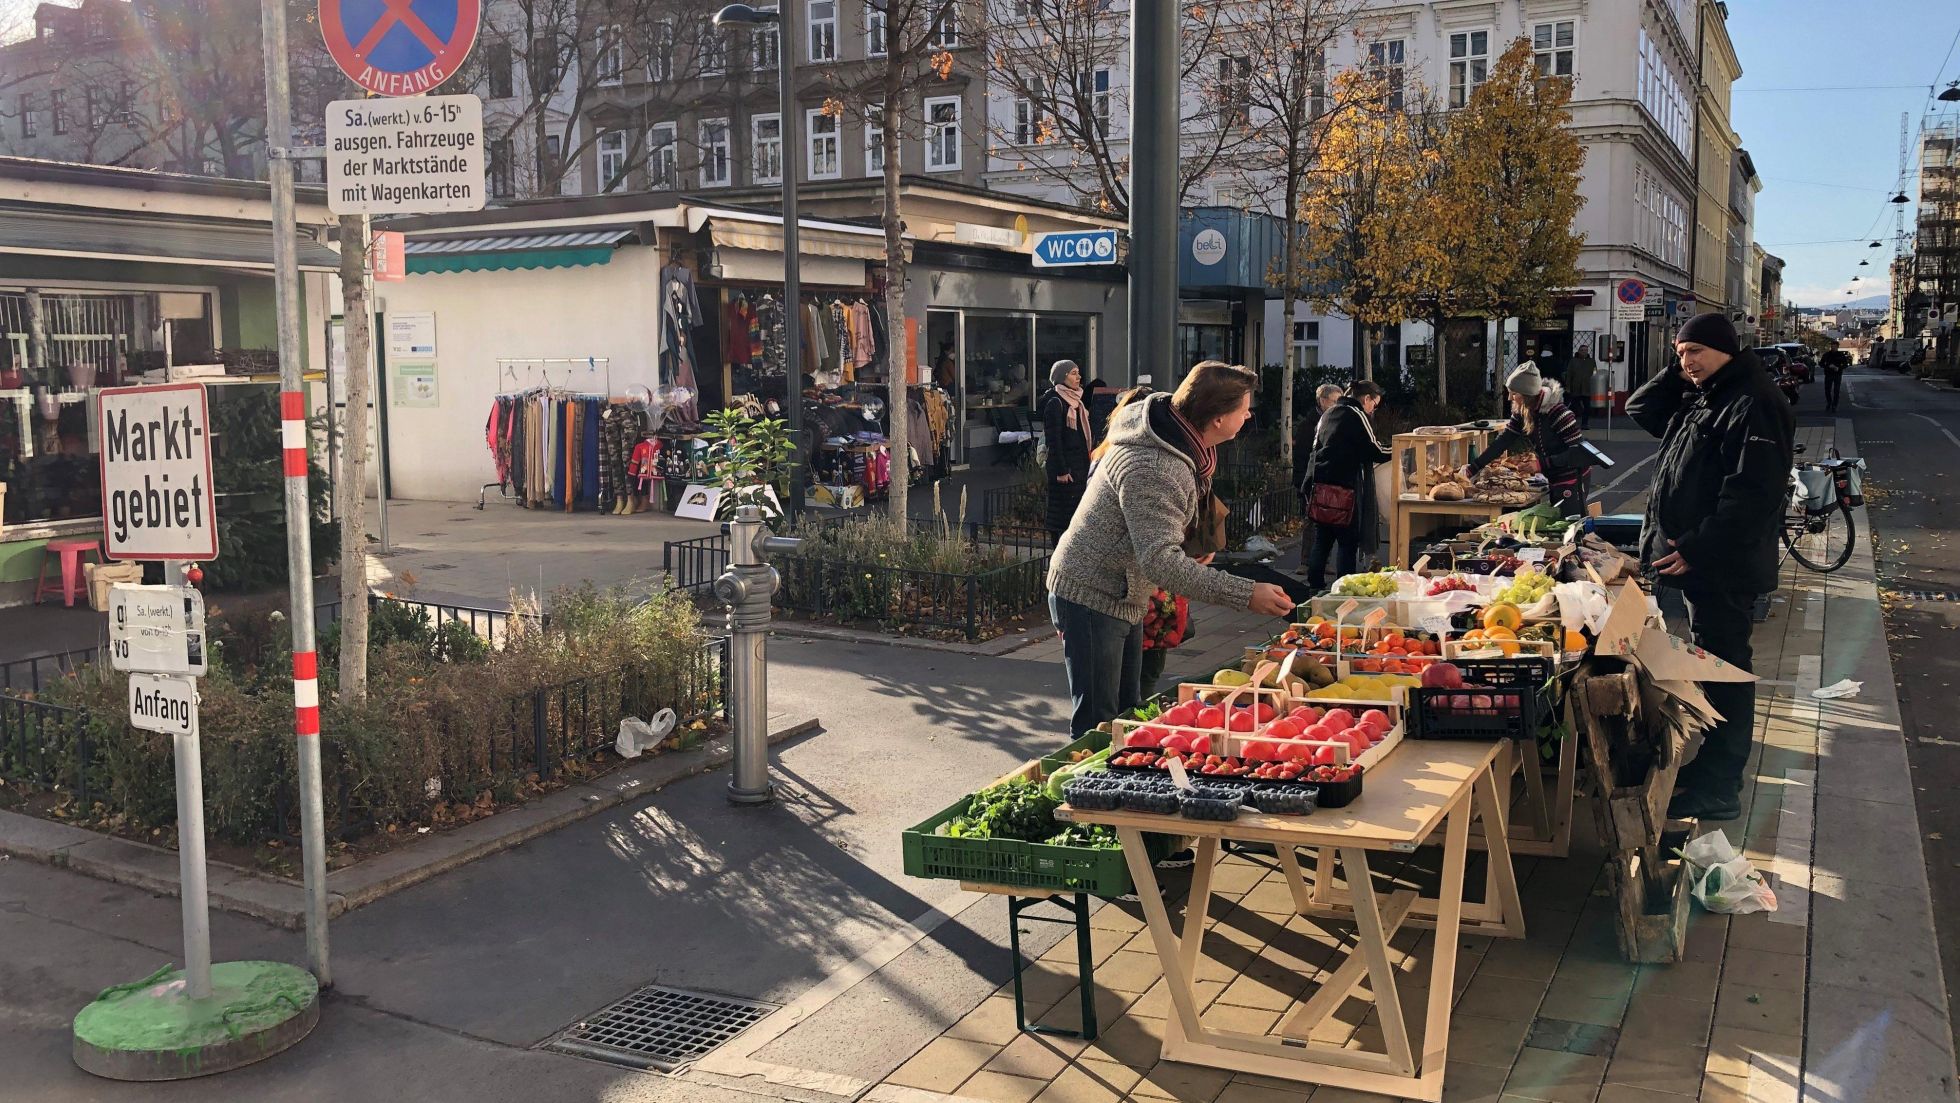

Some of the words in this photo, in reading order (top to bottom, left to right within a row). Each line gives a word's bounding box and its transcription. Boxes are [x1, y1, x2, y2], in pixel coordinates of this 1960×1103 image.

[358, 62, 445, 94] ANFANG
[413, 115, 422, 125] v.
[334, 135, 392, 154] ausgen.
[396, 131, 475, 151] Fahrzeuge
[343, 159, 368, 176] der
[372, 155, 468, 176] Marktstände
[342, 183, 367, 202] mit
[371, 182, 471, 205] Wagenkarten
[1047, 239, 1075, 259] WC
[106, 404, 202, 462] Markt-
[112, 473, 202, 544] gebiet
[134, 686, 189, 729] Anfang
